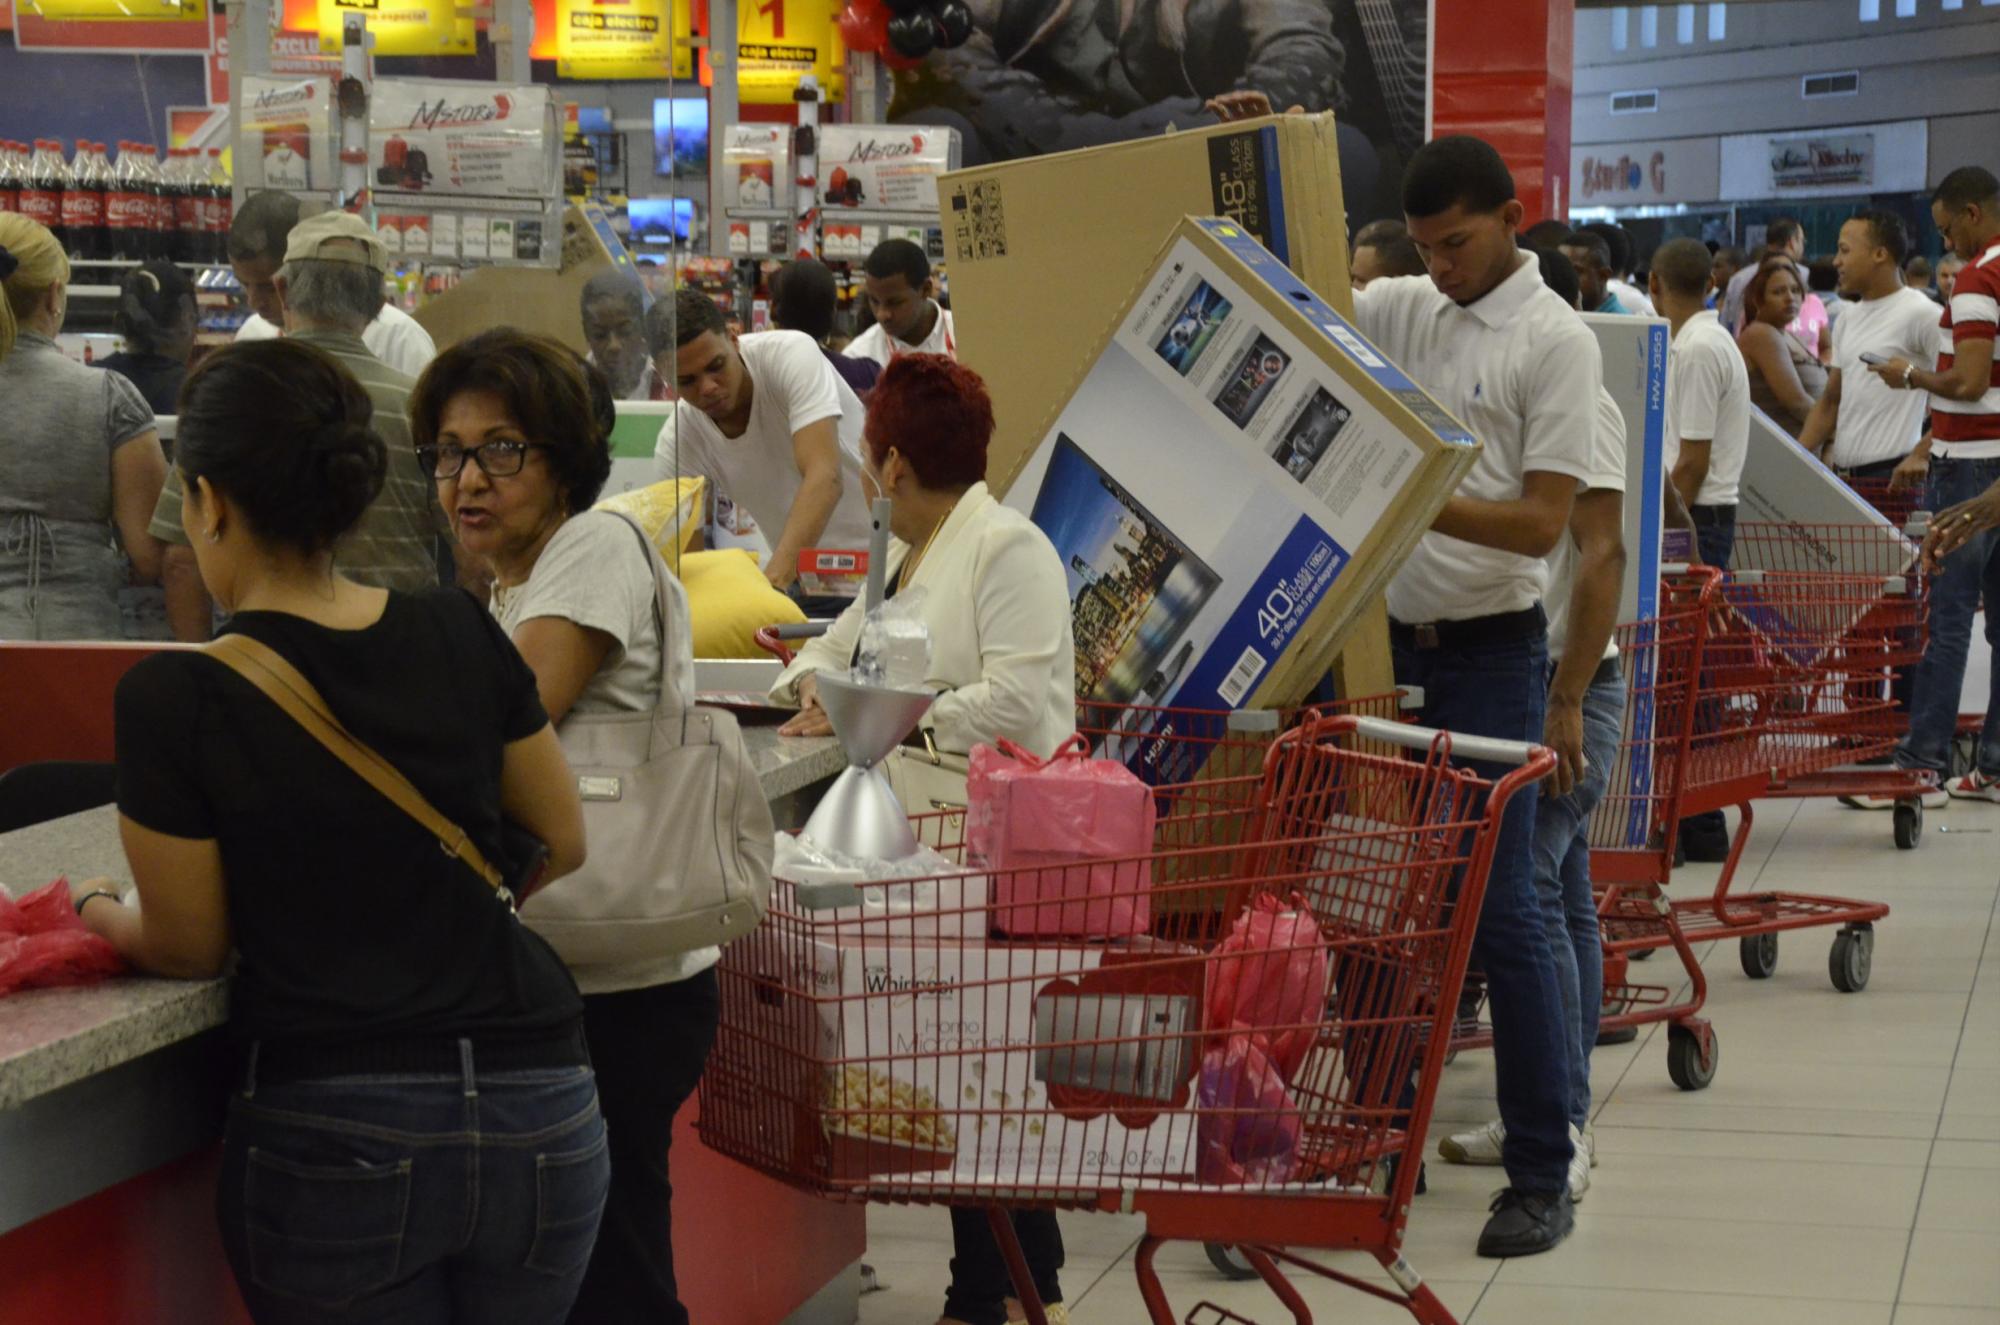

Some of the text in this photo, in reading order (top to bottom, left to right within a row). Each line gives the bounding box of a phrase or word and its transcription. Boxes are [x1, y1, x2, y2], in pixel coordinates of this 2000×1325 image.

[770, 47, 815, 61] electro
[1231, 138, 1242, 180] CLASS
[1651, 330, 1662, 410] HW-J355
[1257, 578, 1293, 638] 40"
[867, 975, 954, 999] Whirpool
